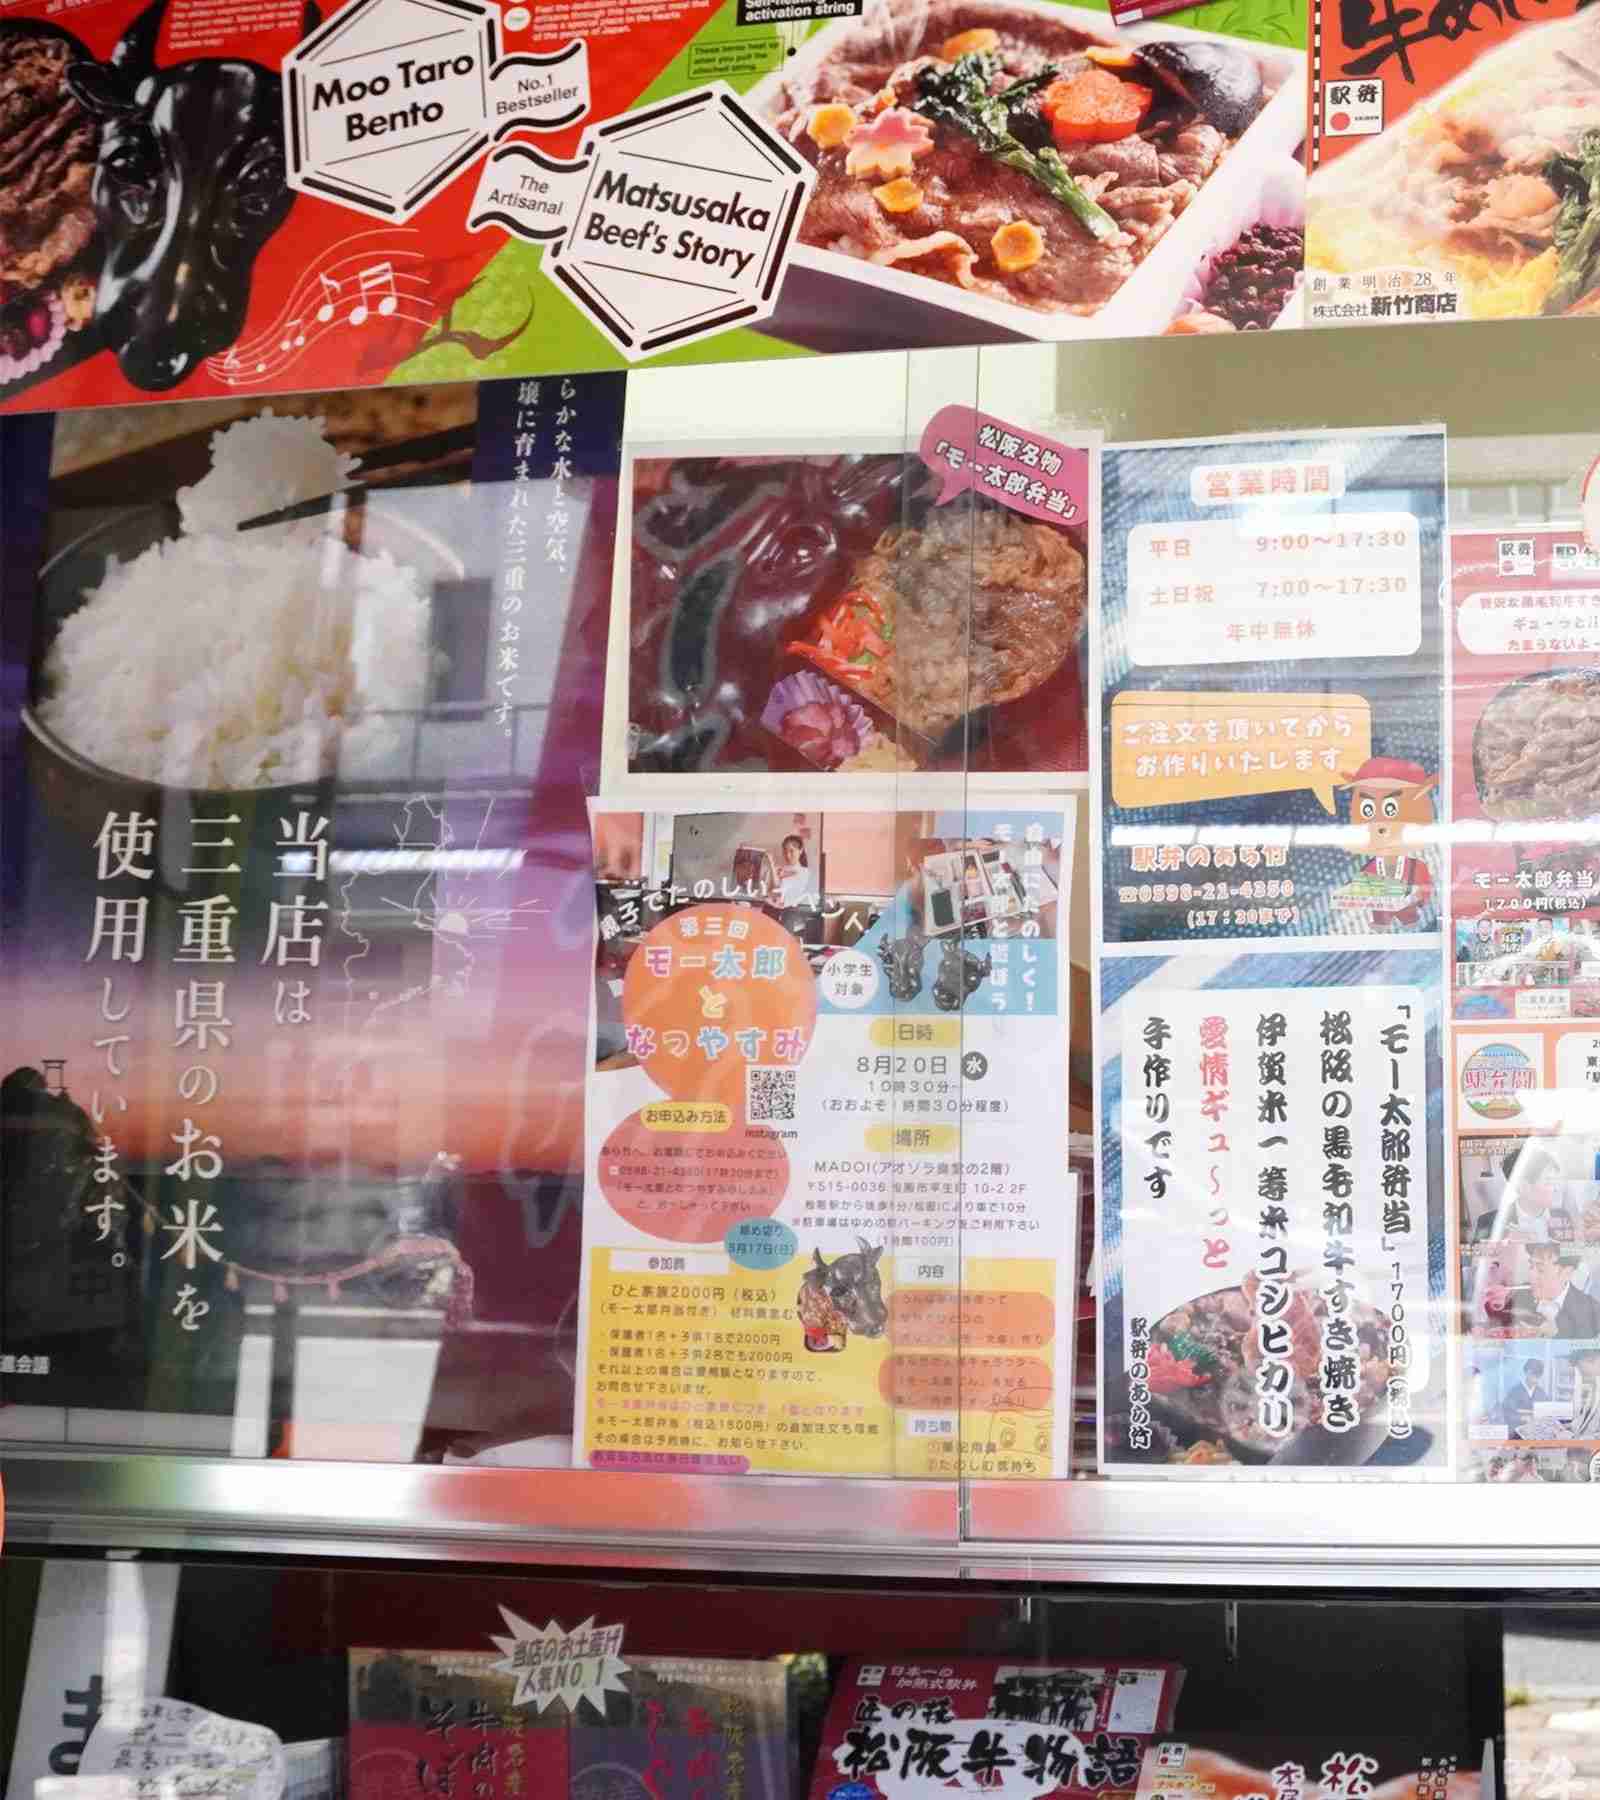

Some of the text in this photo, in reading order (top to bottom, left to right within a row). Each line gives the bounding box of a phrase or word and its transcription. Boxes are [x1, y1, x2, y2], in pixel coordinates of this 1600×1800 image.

[745, 6, 812, 22] activation
[815, 2, 855, 15] string
[312, 51, 474, 111] Moo Taro
[496, 87, 579, 114] Bestseller
[345, 99, 445, 142] Bento
[520, 175, 549, 196] The
[488, 189, 564, 217] Artisanal
[594, 171, 770, 231] Matsusaka
[585, 213, 756, 279] Beef's Story
[1313, 272, 1456, 291] 創業明治28年
[1313, 293, 1457, 318] 株式会社新竹商店
[978, 424, 1063, 477] 松阪名物
[935, 440, 1077, 520] 「モー太郎弁当」
[1205, 464, 1331, 499] 営業時間
[1149, 538, 1192, 559] 平日
[1149, 583, 1216, 607] 土日祝
[1225, 618, 1317, 643] 年中無休
[1121, 714, 1354, 746] ご注文を頂いてから
[1135, 749, 1342, 778] お作りいたします
[1474, 870, 1595, 890] モー太郎弁当
[260, 811, 331, 1024] 当店は
[679, 917, 749, 941] 第三回
[644, 944, 789, 981] モー太郎
[826, 962, 874, 978] 小学生
[699, 984, 728, 1019] と
[834, 982, 864, 998] 対象
[85, 810, 159, 1269] 使用しています。
[625, 1023, 807, 1059] なつやすみ
[898, 1024, 934, 1042] 日時
[160, 812, 244, 1331] 三重県のお米を
[963, 1054, 986, 1077] 水
[645, 1109, 727, 1124] お申込み方法
[1143, 1016, 1173, 1200] 手作りです
[895, 1128, 931, 1147] 場所
[1320, 1010, 1357, 1428] 松阪の黒毛和牛すき焼き
[918, 1264, 945, 1279] 内容
[844, 1728, 1140, 1787] 松阪牛物語
